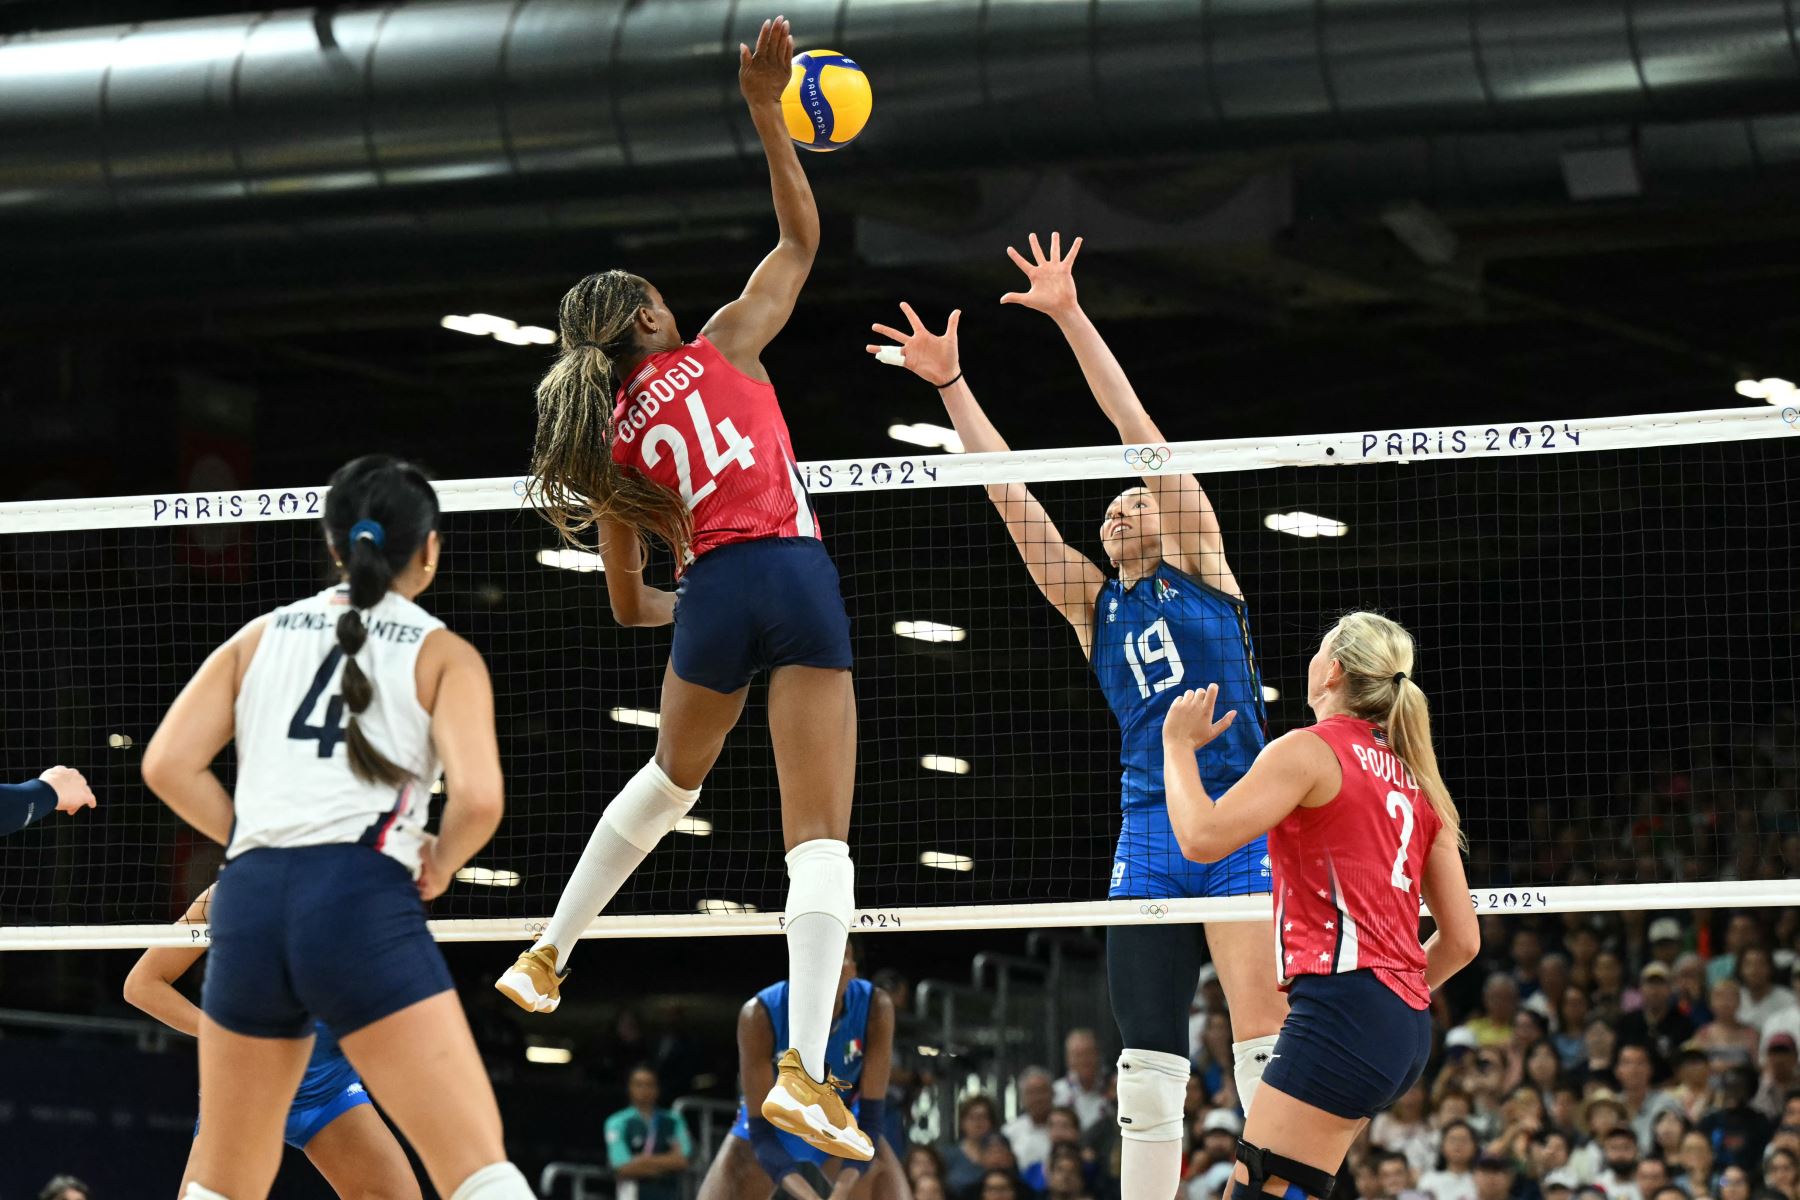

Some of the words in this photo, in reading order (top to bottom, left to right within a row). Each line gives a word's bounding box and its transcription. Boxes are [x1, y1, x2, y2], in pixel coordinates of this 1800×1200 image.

[807, 77, 819, 107] PARIS
[814, 109, 827, 135] 2024
[618, 355, 704, 443] OGBOGU
[641, 389, 756, 511] 24
[1362, 430, 1467, 457] PARIS
[1484, 423, 1580, 451] 2024
[849, 460, 936, 486] 2024
[154, 495, 243, 520] PARIS
[258, 492, 319, 516] 202
[1124, 616, 1184, 700] 19
[288, 643, 347, 758] 4
[1386, 790, 1413, 893] 2
[852, 913, 901, 928] 024
[1488, 892, 1546, 908] 2024
